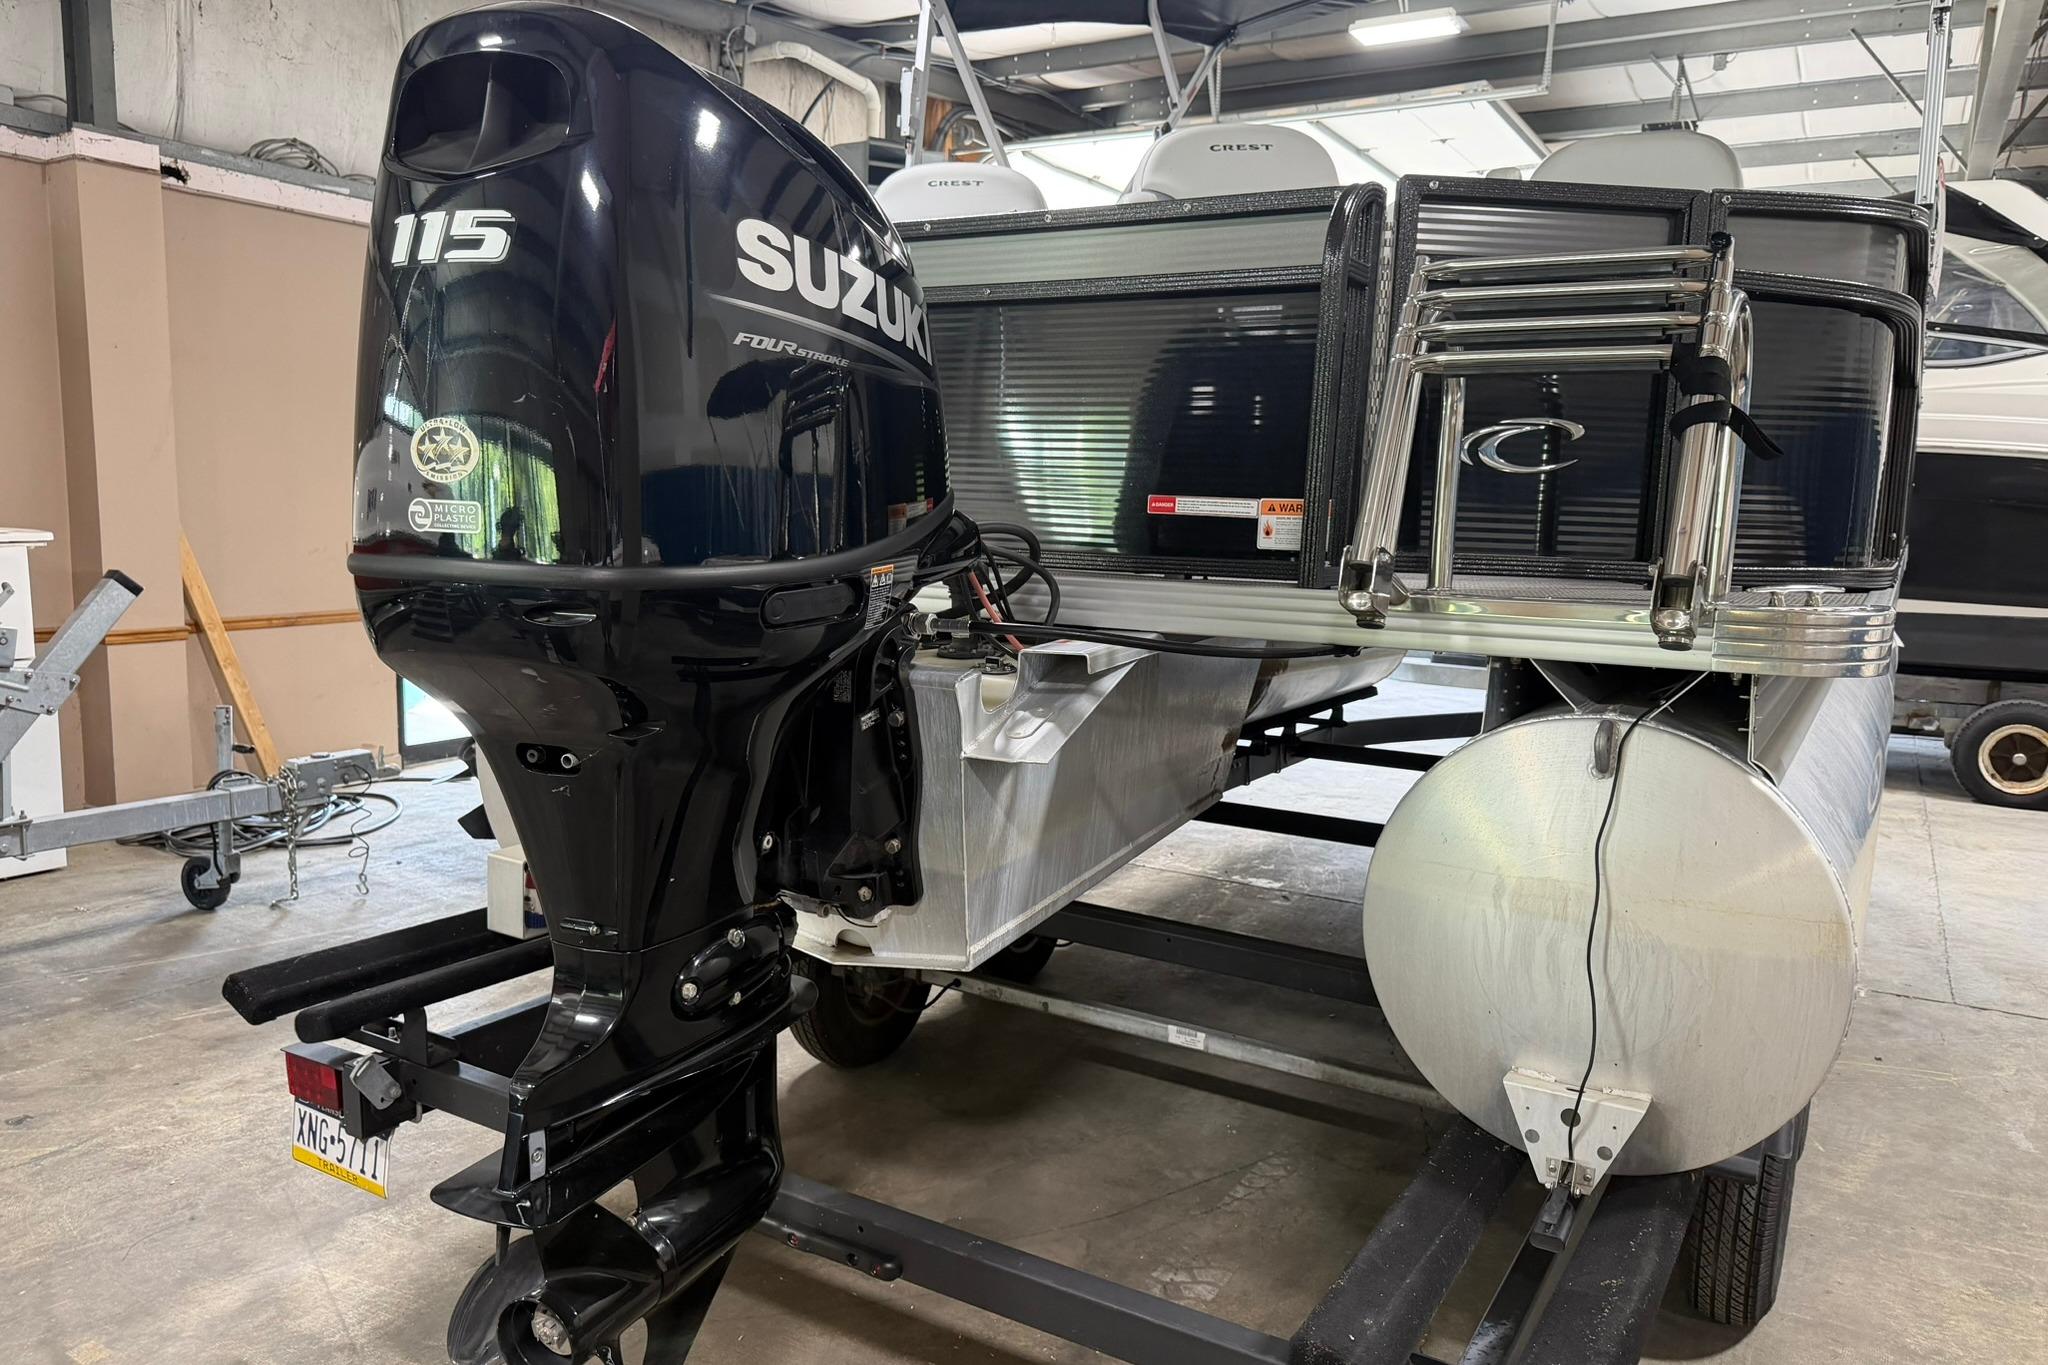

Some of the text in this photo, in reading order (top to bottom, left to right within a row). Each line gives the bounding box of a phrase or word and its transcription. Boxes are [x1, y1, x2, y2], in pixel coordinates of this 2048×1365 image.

[1209, 144, 1274, 152] CREST
[391, 209, 516, 267] 115
[736, 218, 933, 367] SUZUKI
[434, 504, 476, 514] MICRO
[434, 513, 476, 524] PLASTIC
[315, 1157, 360, 1185] TRAILER
